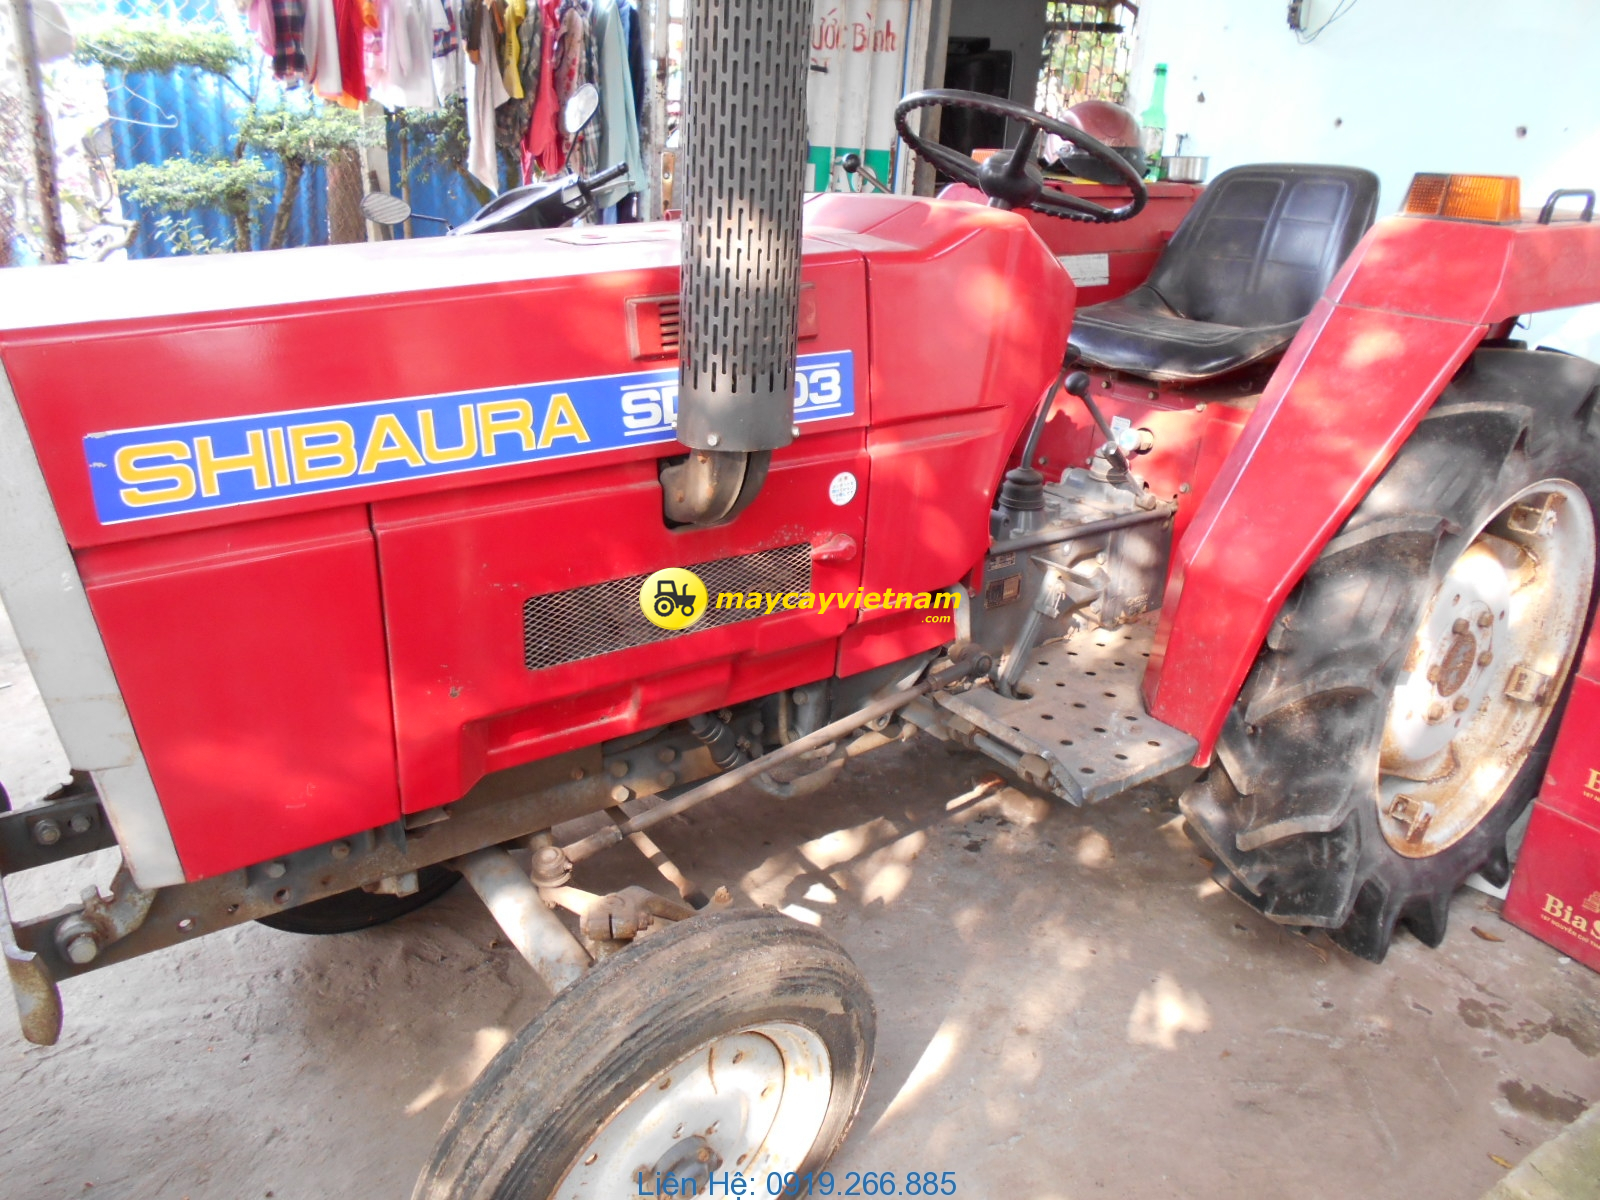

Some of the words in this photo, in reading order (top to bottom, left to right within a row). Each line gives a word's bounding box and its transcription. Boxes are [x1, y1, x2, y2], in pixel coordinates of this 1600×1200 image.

[852, 12, 897, 52] Bình
[114, 392, 592, 508] SHIBAURA
[1541, 892, 1588, 933] Bia
